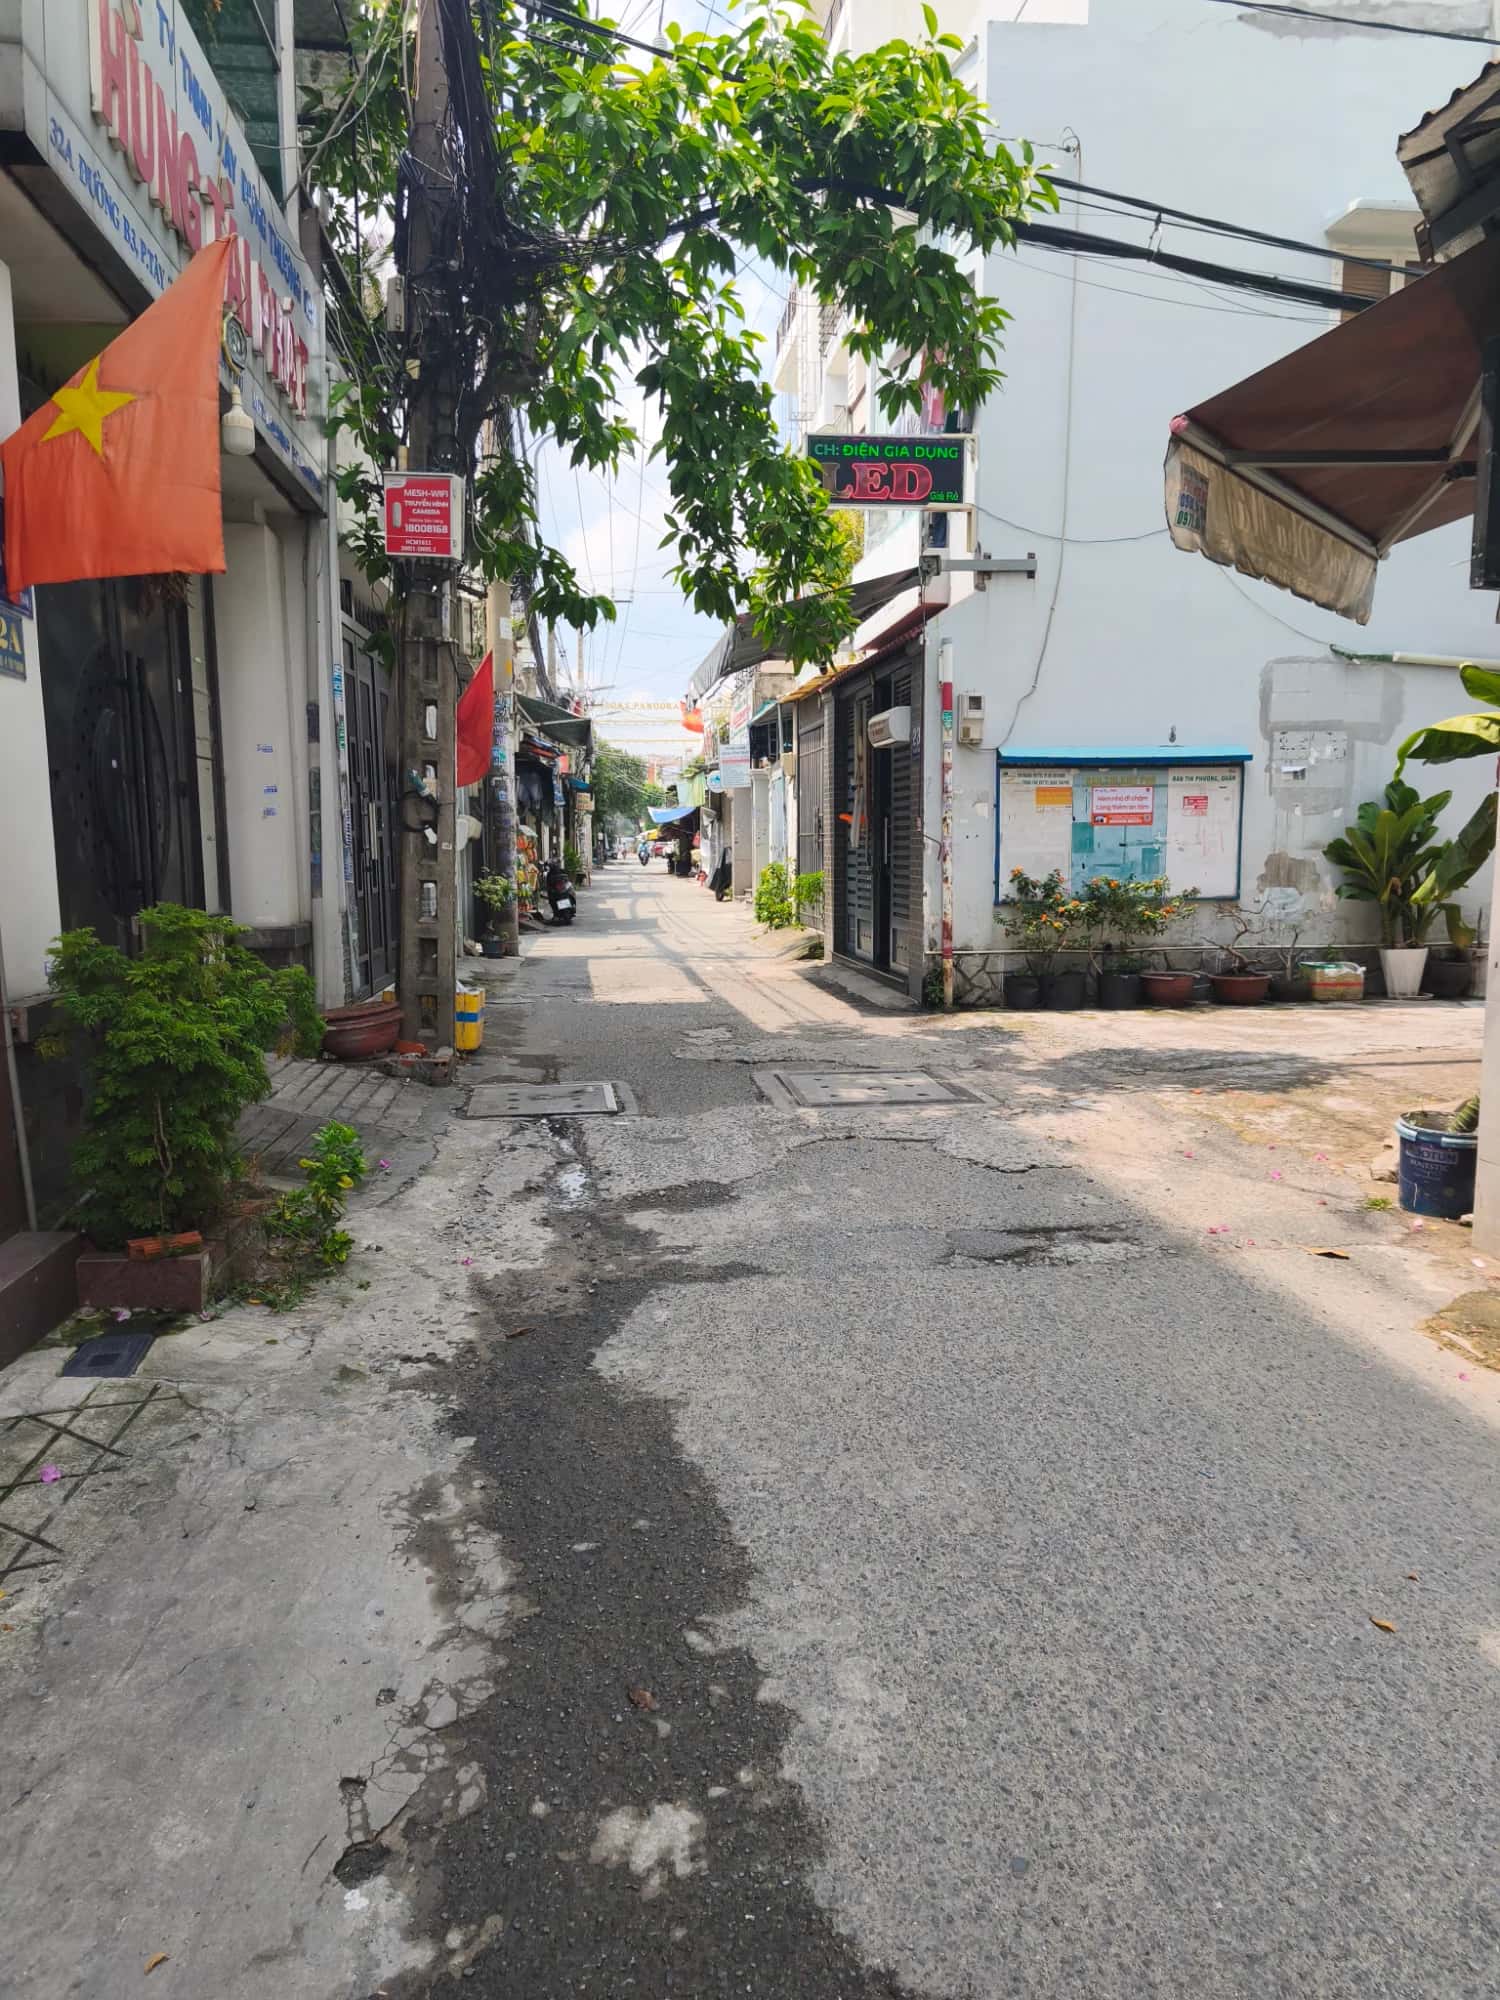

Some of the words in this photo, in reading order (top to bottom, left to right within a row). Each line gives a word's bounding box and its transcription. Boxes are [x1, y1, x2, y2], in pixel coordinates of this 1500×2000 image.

[814, 444, 839, 455] CH:
[843, 442, 879, 459] ĐIỆN
[884, 446, 910, 457] GIA
[915, 447, 959, 459] DỤNG
[821, 462, 932, 500] LED
[404, 489, 449, 498] MESH-WIFI
